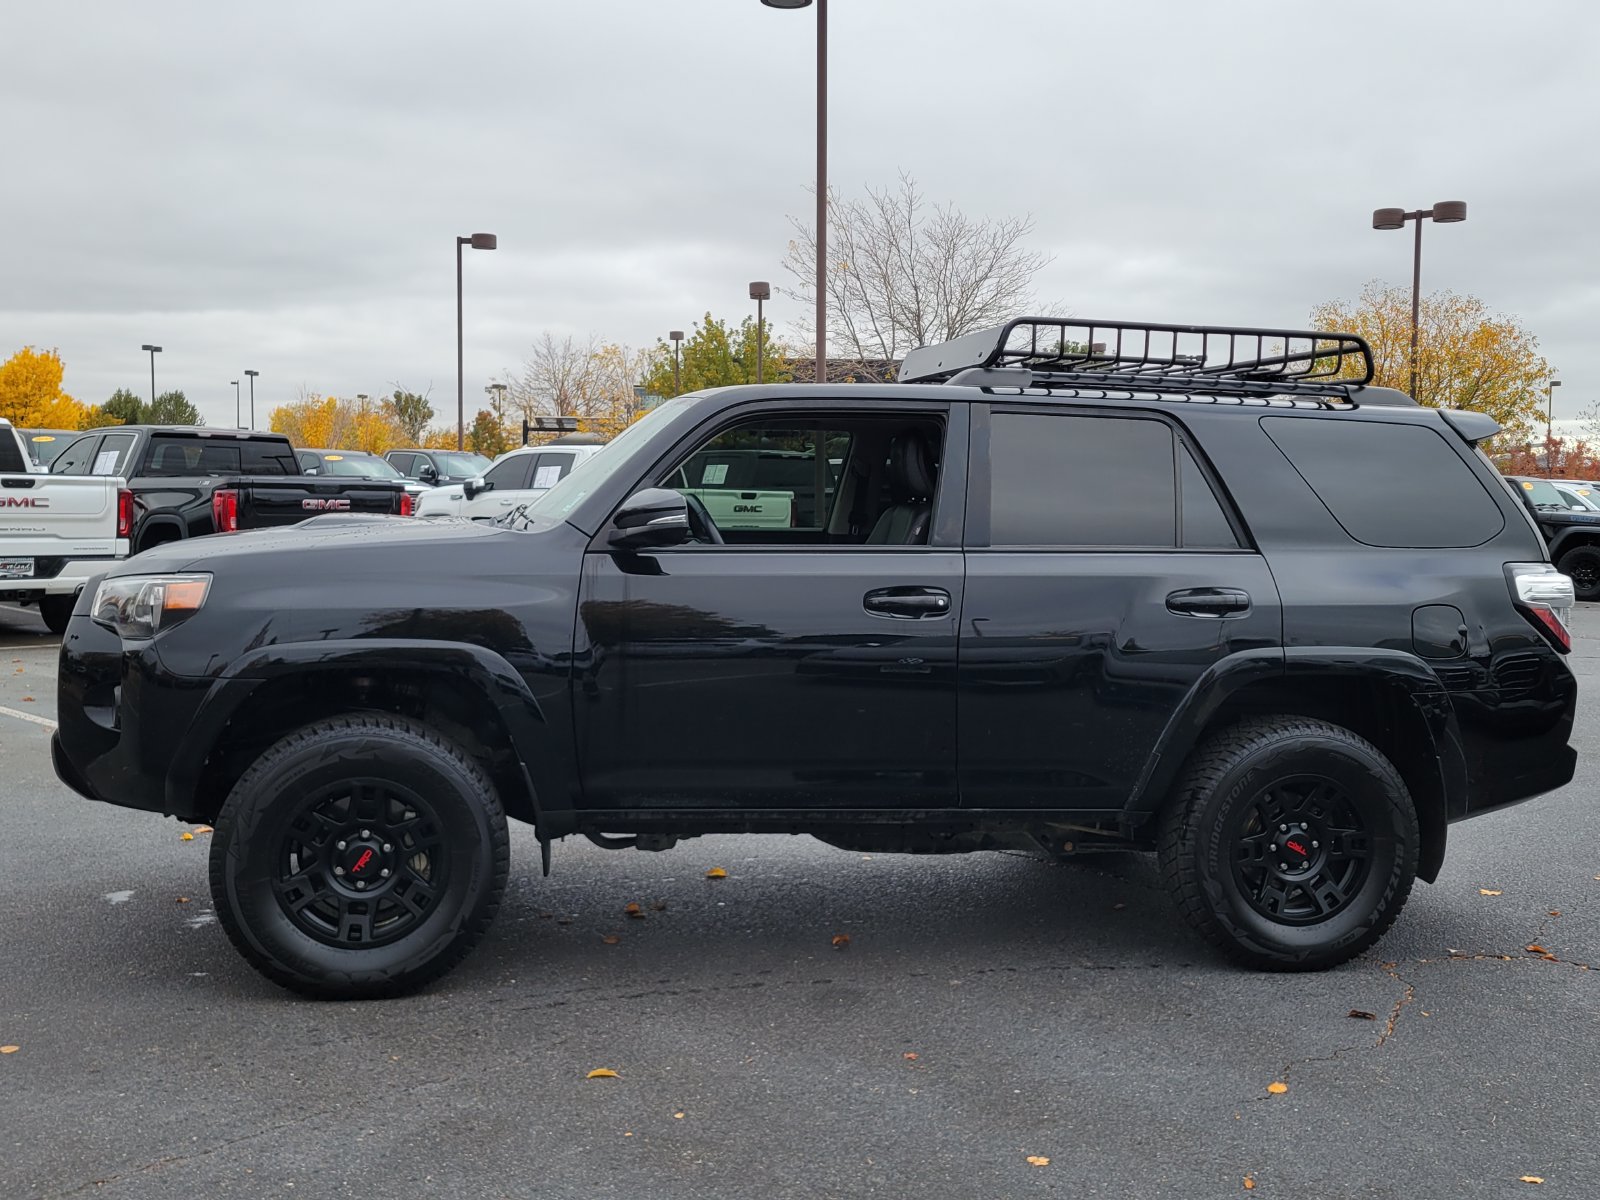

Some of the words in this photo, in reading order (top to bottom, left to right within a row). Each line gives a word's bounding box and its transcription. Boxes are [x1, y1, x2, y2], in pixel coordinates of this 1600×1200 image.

[0, 497, 50, 508] MC
[302, 498, 351, 510] GMC
[733, 505, 763, 513] GMC
[1208, 770, 1256, 874] BRIDGESTONE
[351, 848, 373, 873] TRD
[1368, 843, 1404, 925] BLIZZAK
